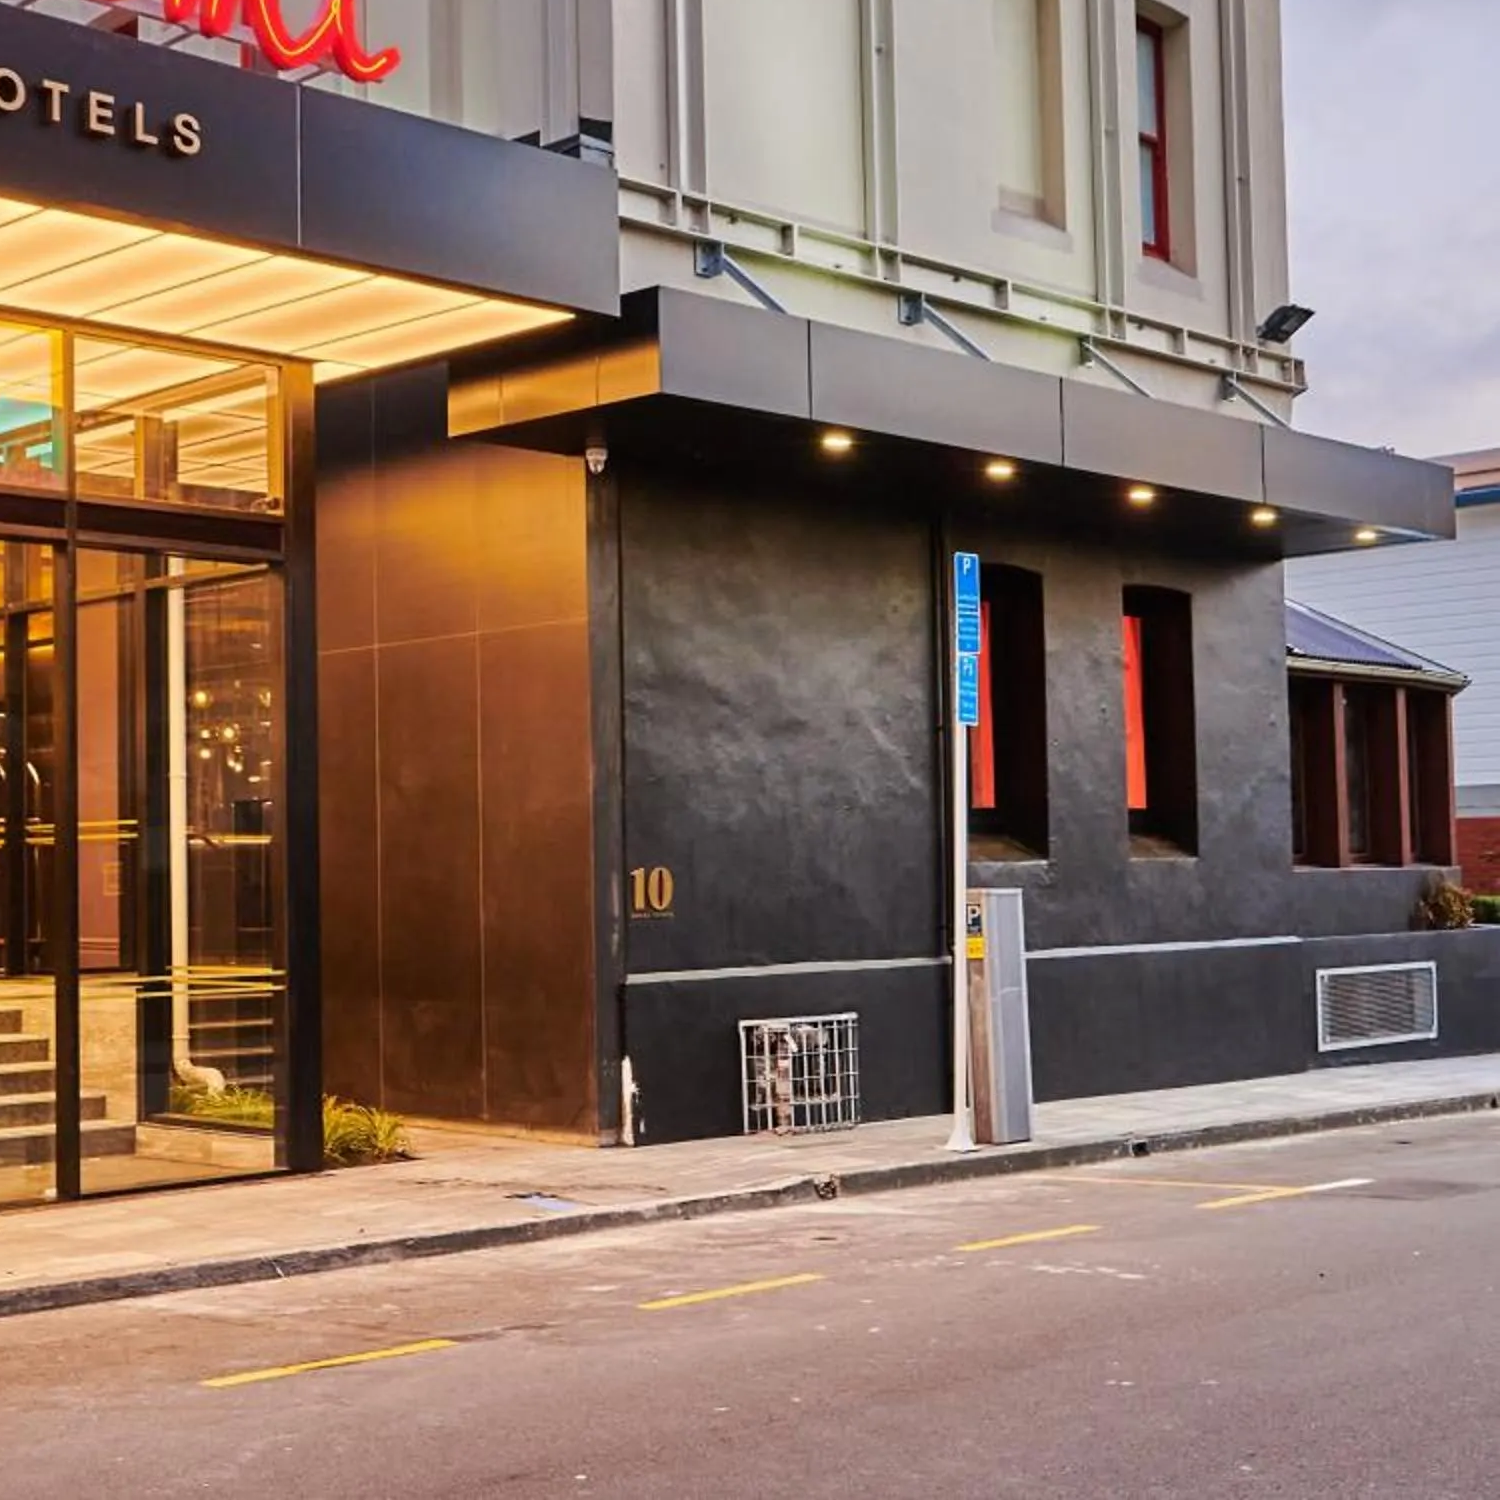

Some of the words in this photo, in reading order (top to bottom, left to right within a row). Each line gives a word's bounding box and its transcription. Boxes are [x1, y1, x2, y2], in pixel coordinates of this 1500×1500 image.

[963, 557, 971, 576] P
[630, 867, 674, 910] 10
[967, 905, 980, 925] P
